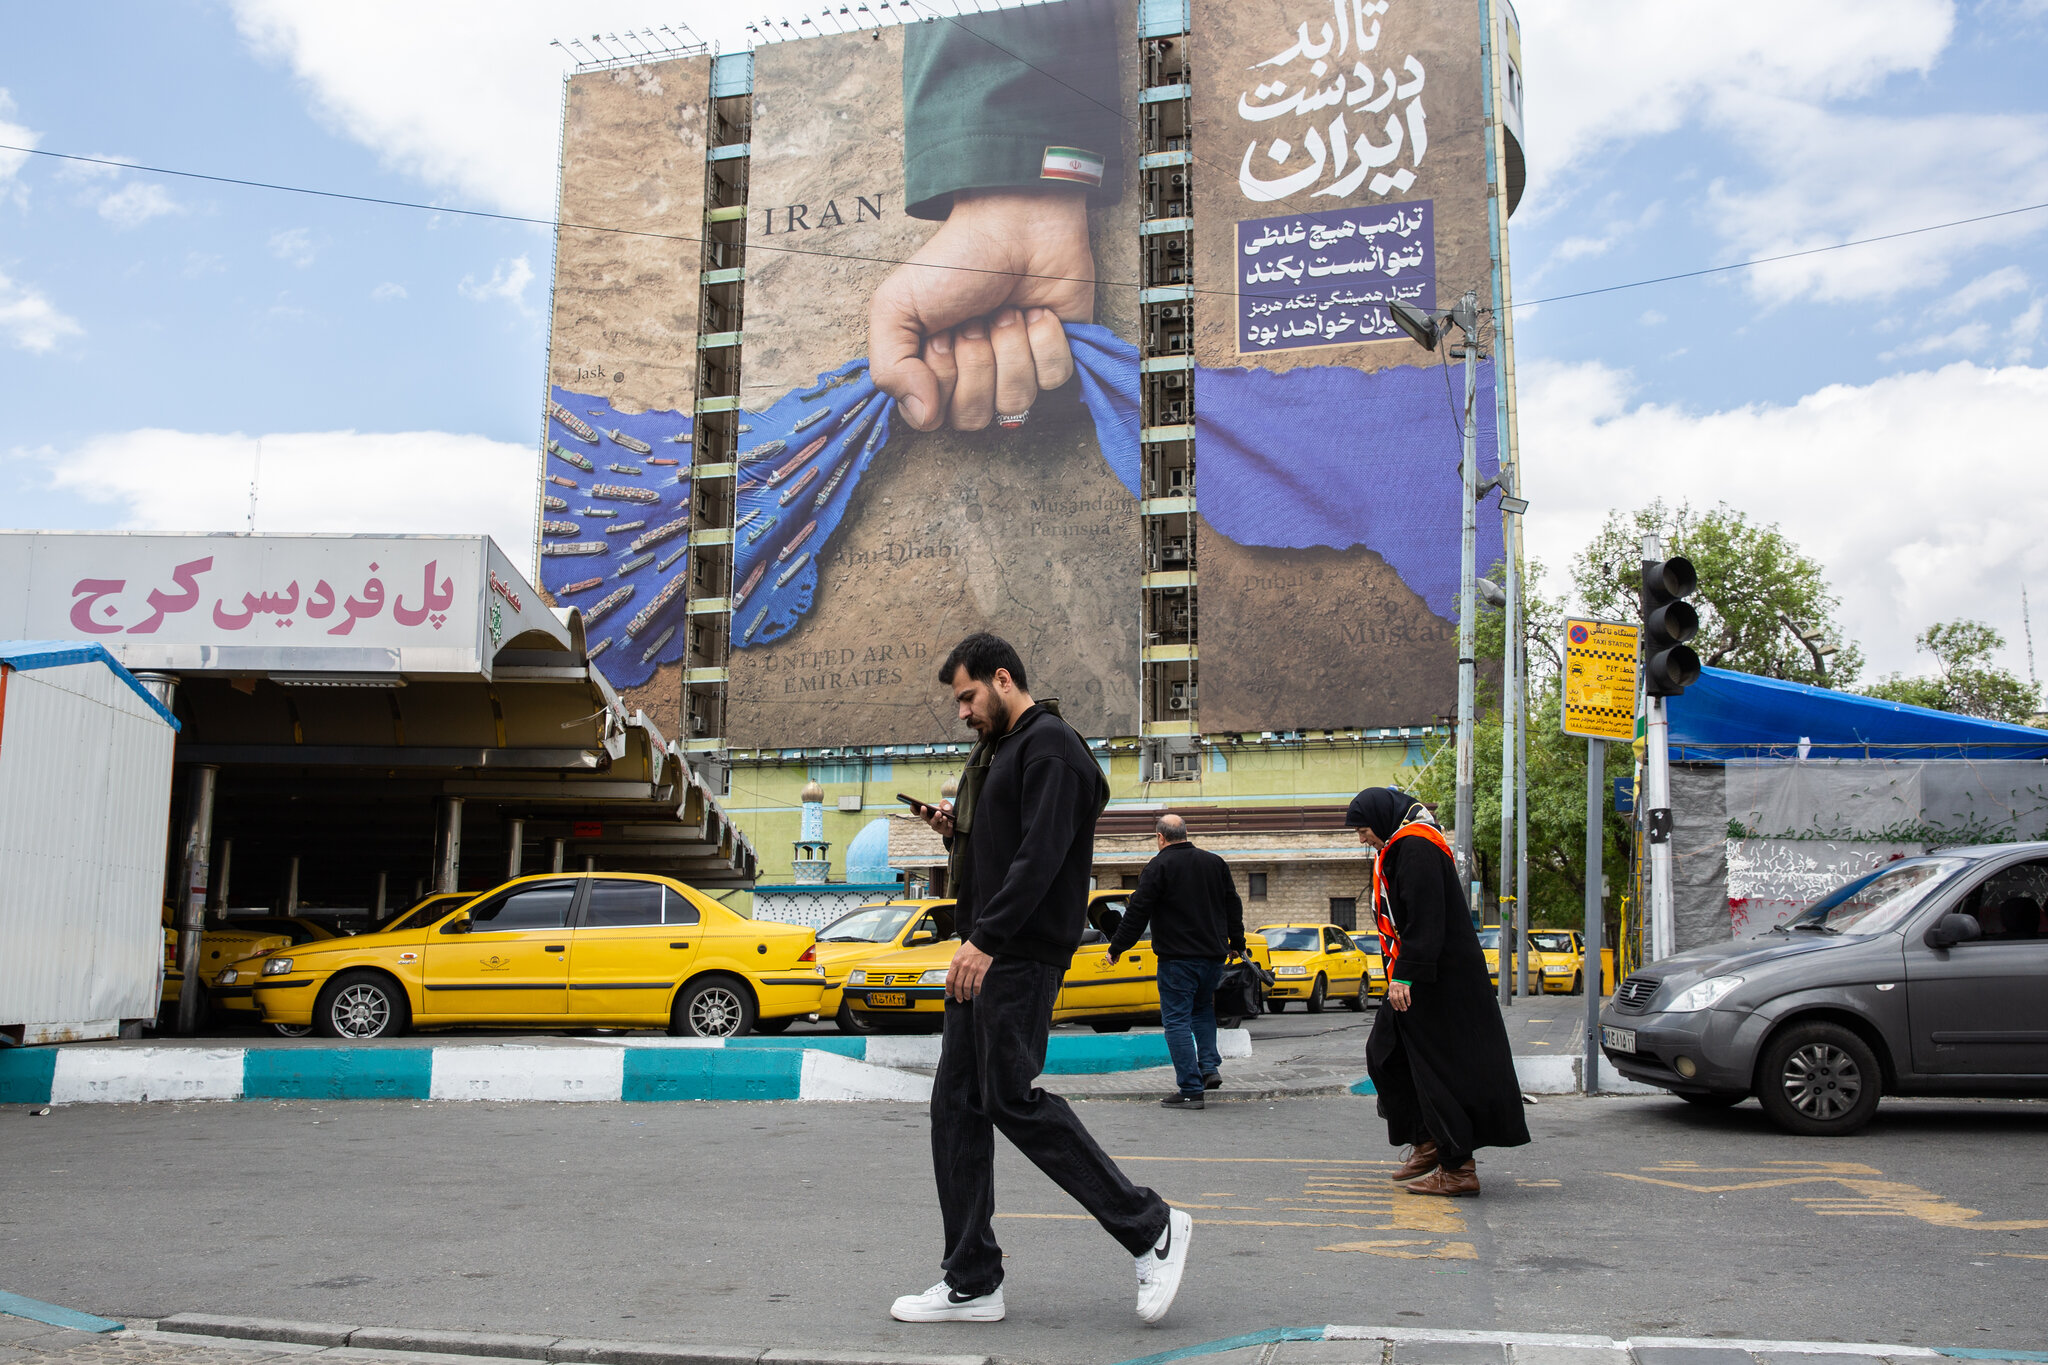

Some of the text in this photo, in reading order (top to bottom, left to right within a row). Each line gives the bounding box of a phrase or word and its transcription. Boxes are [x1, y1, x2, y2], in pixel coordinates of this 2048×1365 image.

[1355, 0, 1390, 52] تا
[1238, 95, 1428, 202] ایران
[764, 193, 884, 236] IRAN
[1244, 206, 1424, 255] ترامپ هیچ غلطی
[1245, 240, 1424, 286] نتوانست بکند
[1247, 300, 1284, 318] هرمز
[1247, 306, 1399, 347] یران خواهد بود
[574, 365, 607, 384] Jask
[885, 539, 961, 562] Dhabi
[69, 555, 214, 635] کرج
[212, 561, 386, 637] فردیس
[393, 559, 456, 631] پل
[1243, 571, 1304, 592] Dubai
[1339, 617, 1451, 643] Muscat
[1593, 638, 1634, 649] TAXI STATION
[1613, 628, 1638, 640] ایستگاه
[765, 642, 928, 672] UNITED ARAB
[784, 667, 903, 694] EMIRATES
